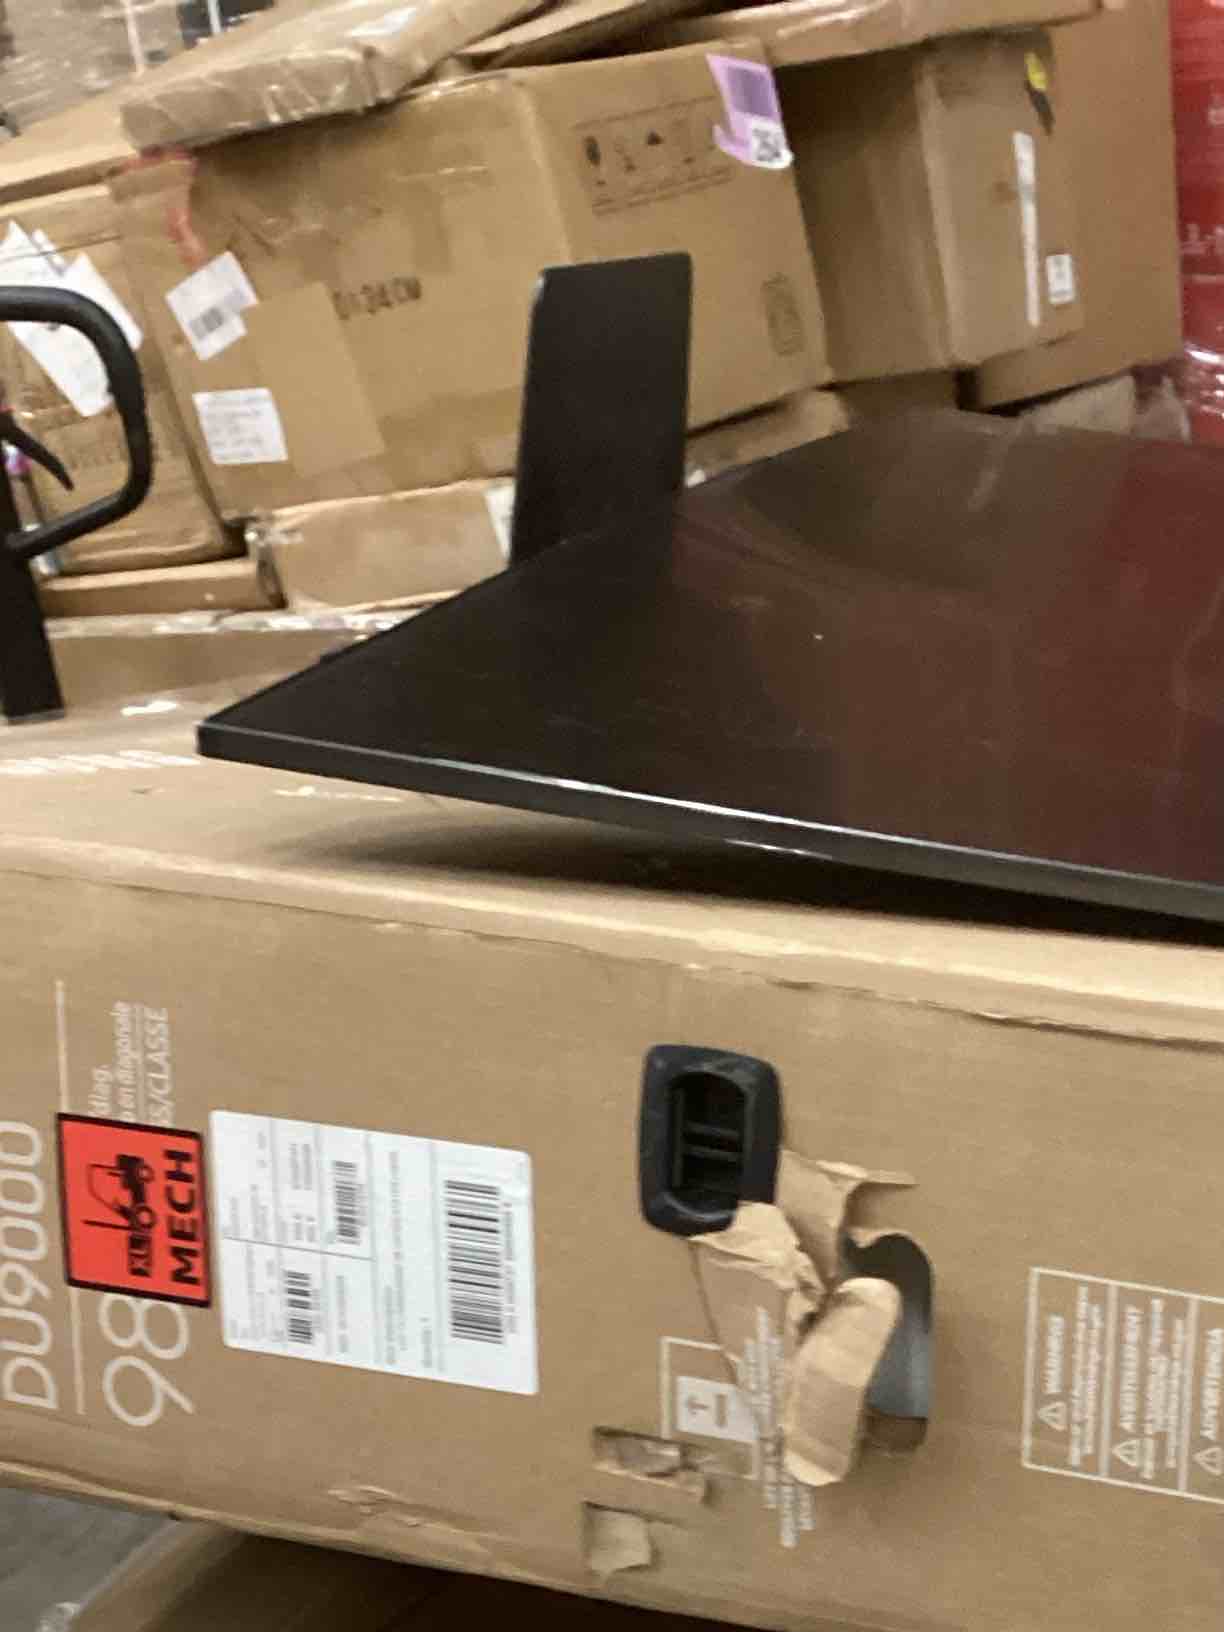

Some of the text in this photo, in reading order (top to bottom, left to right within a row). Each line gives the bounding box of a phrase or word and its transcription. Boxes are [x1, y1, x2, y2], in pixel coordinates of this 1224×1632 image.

[0, 1121, 58, 1411] DU9000
[162, 1148, 203, 1287] MECH
[100, 1293, 196, 1427] 98
